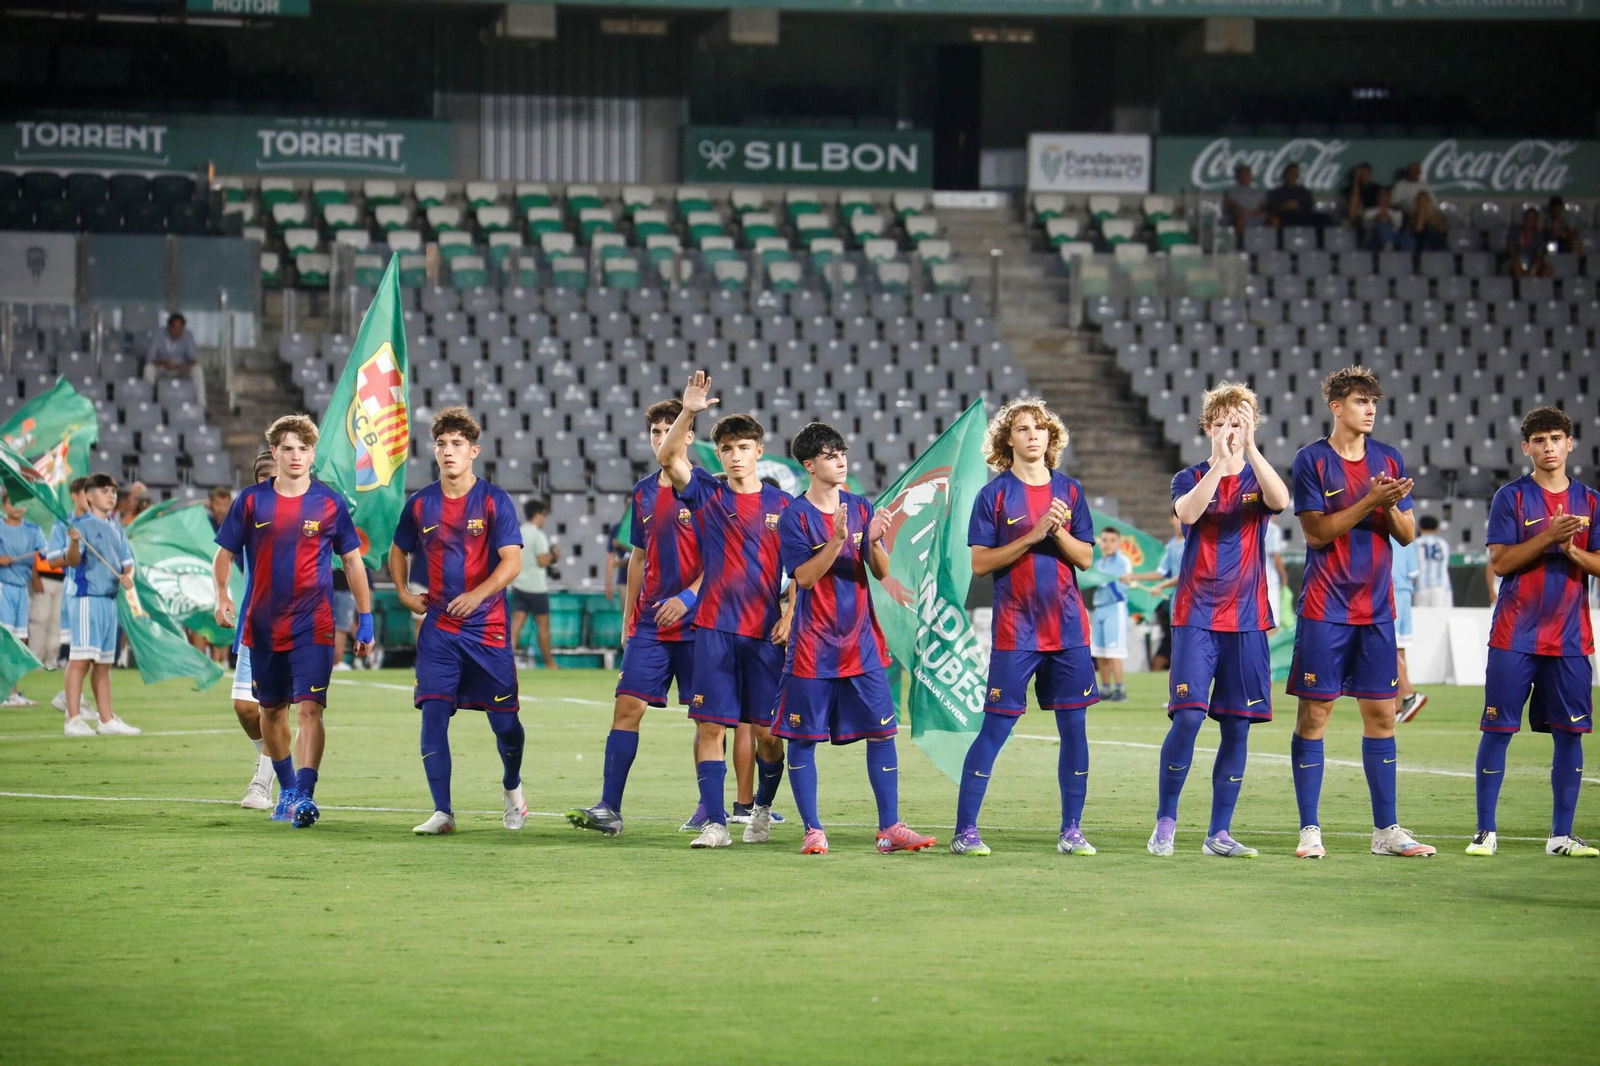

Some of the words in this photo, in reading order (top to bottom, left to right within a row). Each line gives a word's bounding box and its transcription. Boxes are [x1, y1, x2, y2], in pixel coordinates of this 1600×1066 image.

[212, 0, 279, 14] MOTOR
[15, 120, 168, 154] TORRENT
[256, 128, 405, 162] TORRENT
[743, 141, 918, 172] SILBON
[1419, 138, 1577, 192] Coca-Cola
[942, 700, 969, 728] JUVENIL
